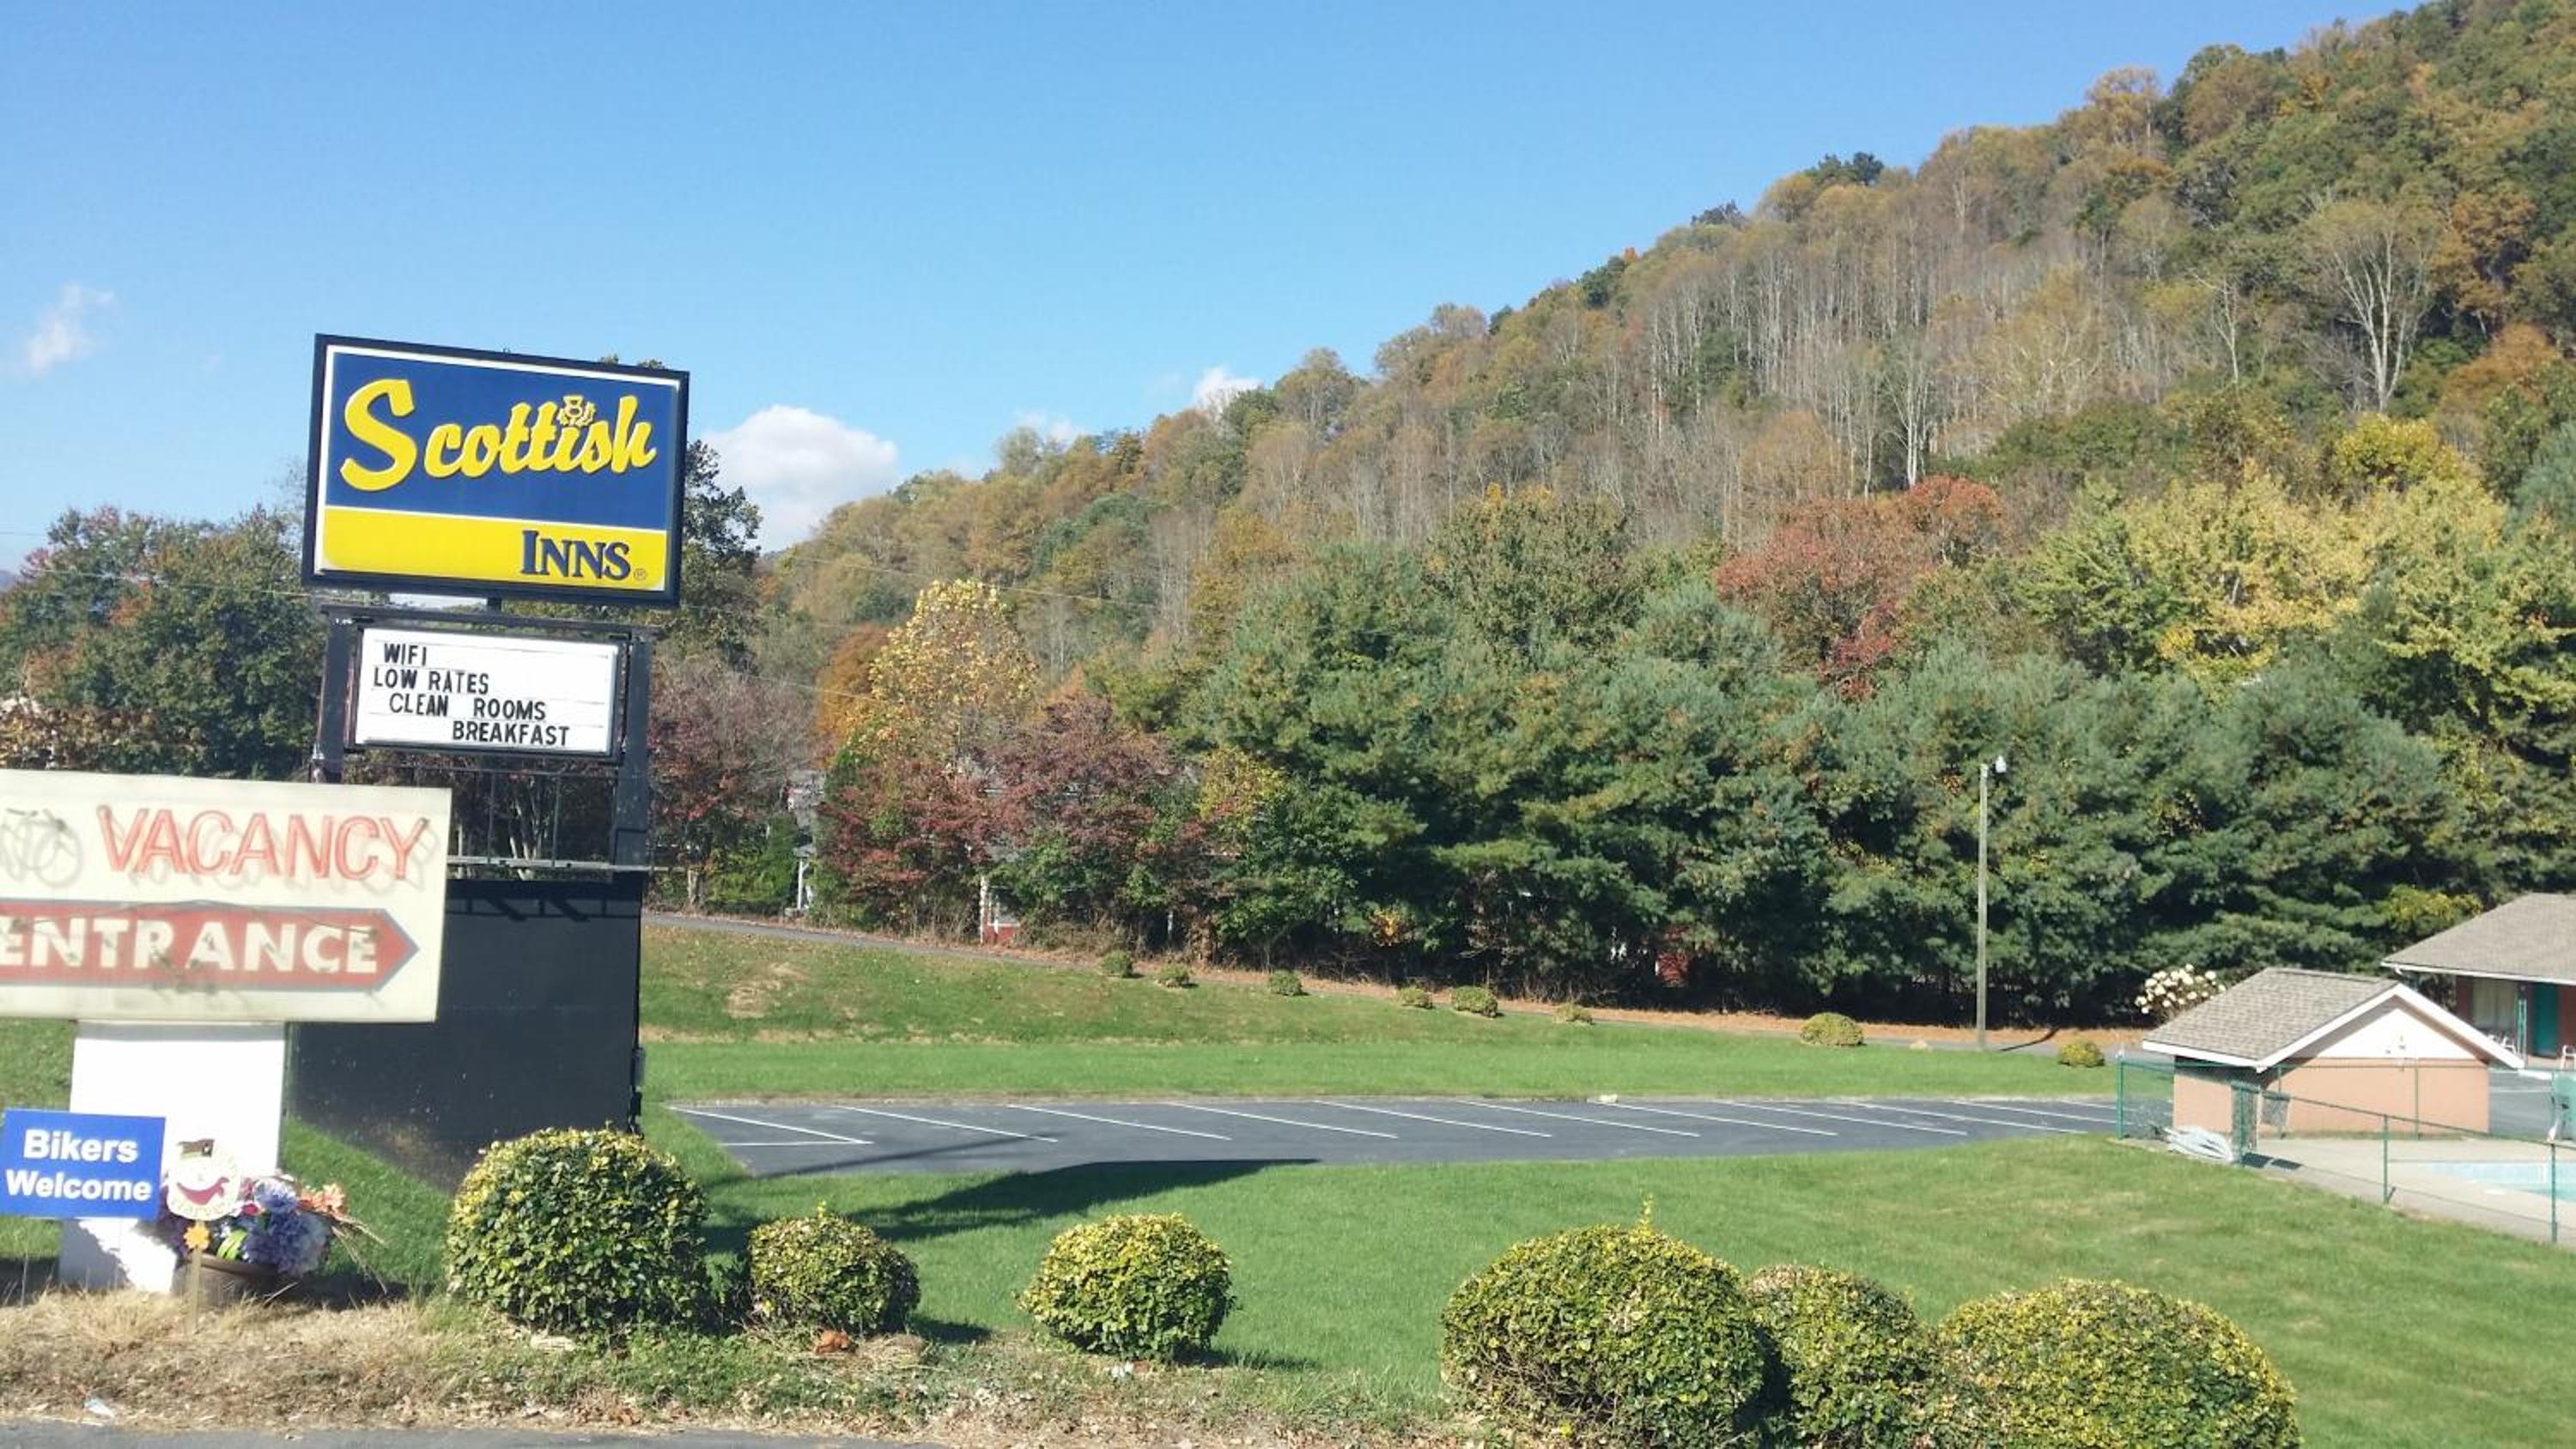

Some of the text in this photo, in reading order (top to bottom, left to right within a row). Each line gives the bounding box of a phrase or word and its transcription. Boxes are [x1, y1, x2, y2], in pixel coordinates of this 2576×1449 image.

[340, 379, 657, 492] Scottish
[520, 530, 632, 580] INNS
[384, 643, 428, 666] WIFI
[374, 667, 489, 695] LOW RATES
[389, 693, 547, 721] CLEAN ROOMS
[452, 720, 570, 746] BREAKFAST
[96, 804, 430, 881] VACANCY
[0, 916, 377, 973] ENTRANCE
[23, 1129, 138, 1163] Bikers
[5, 1168, 153, 1202] Welcome
